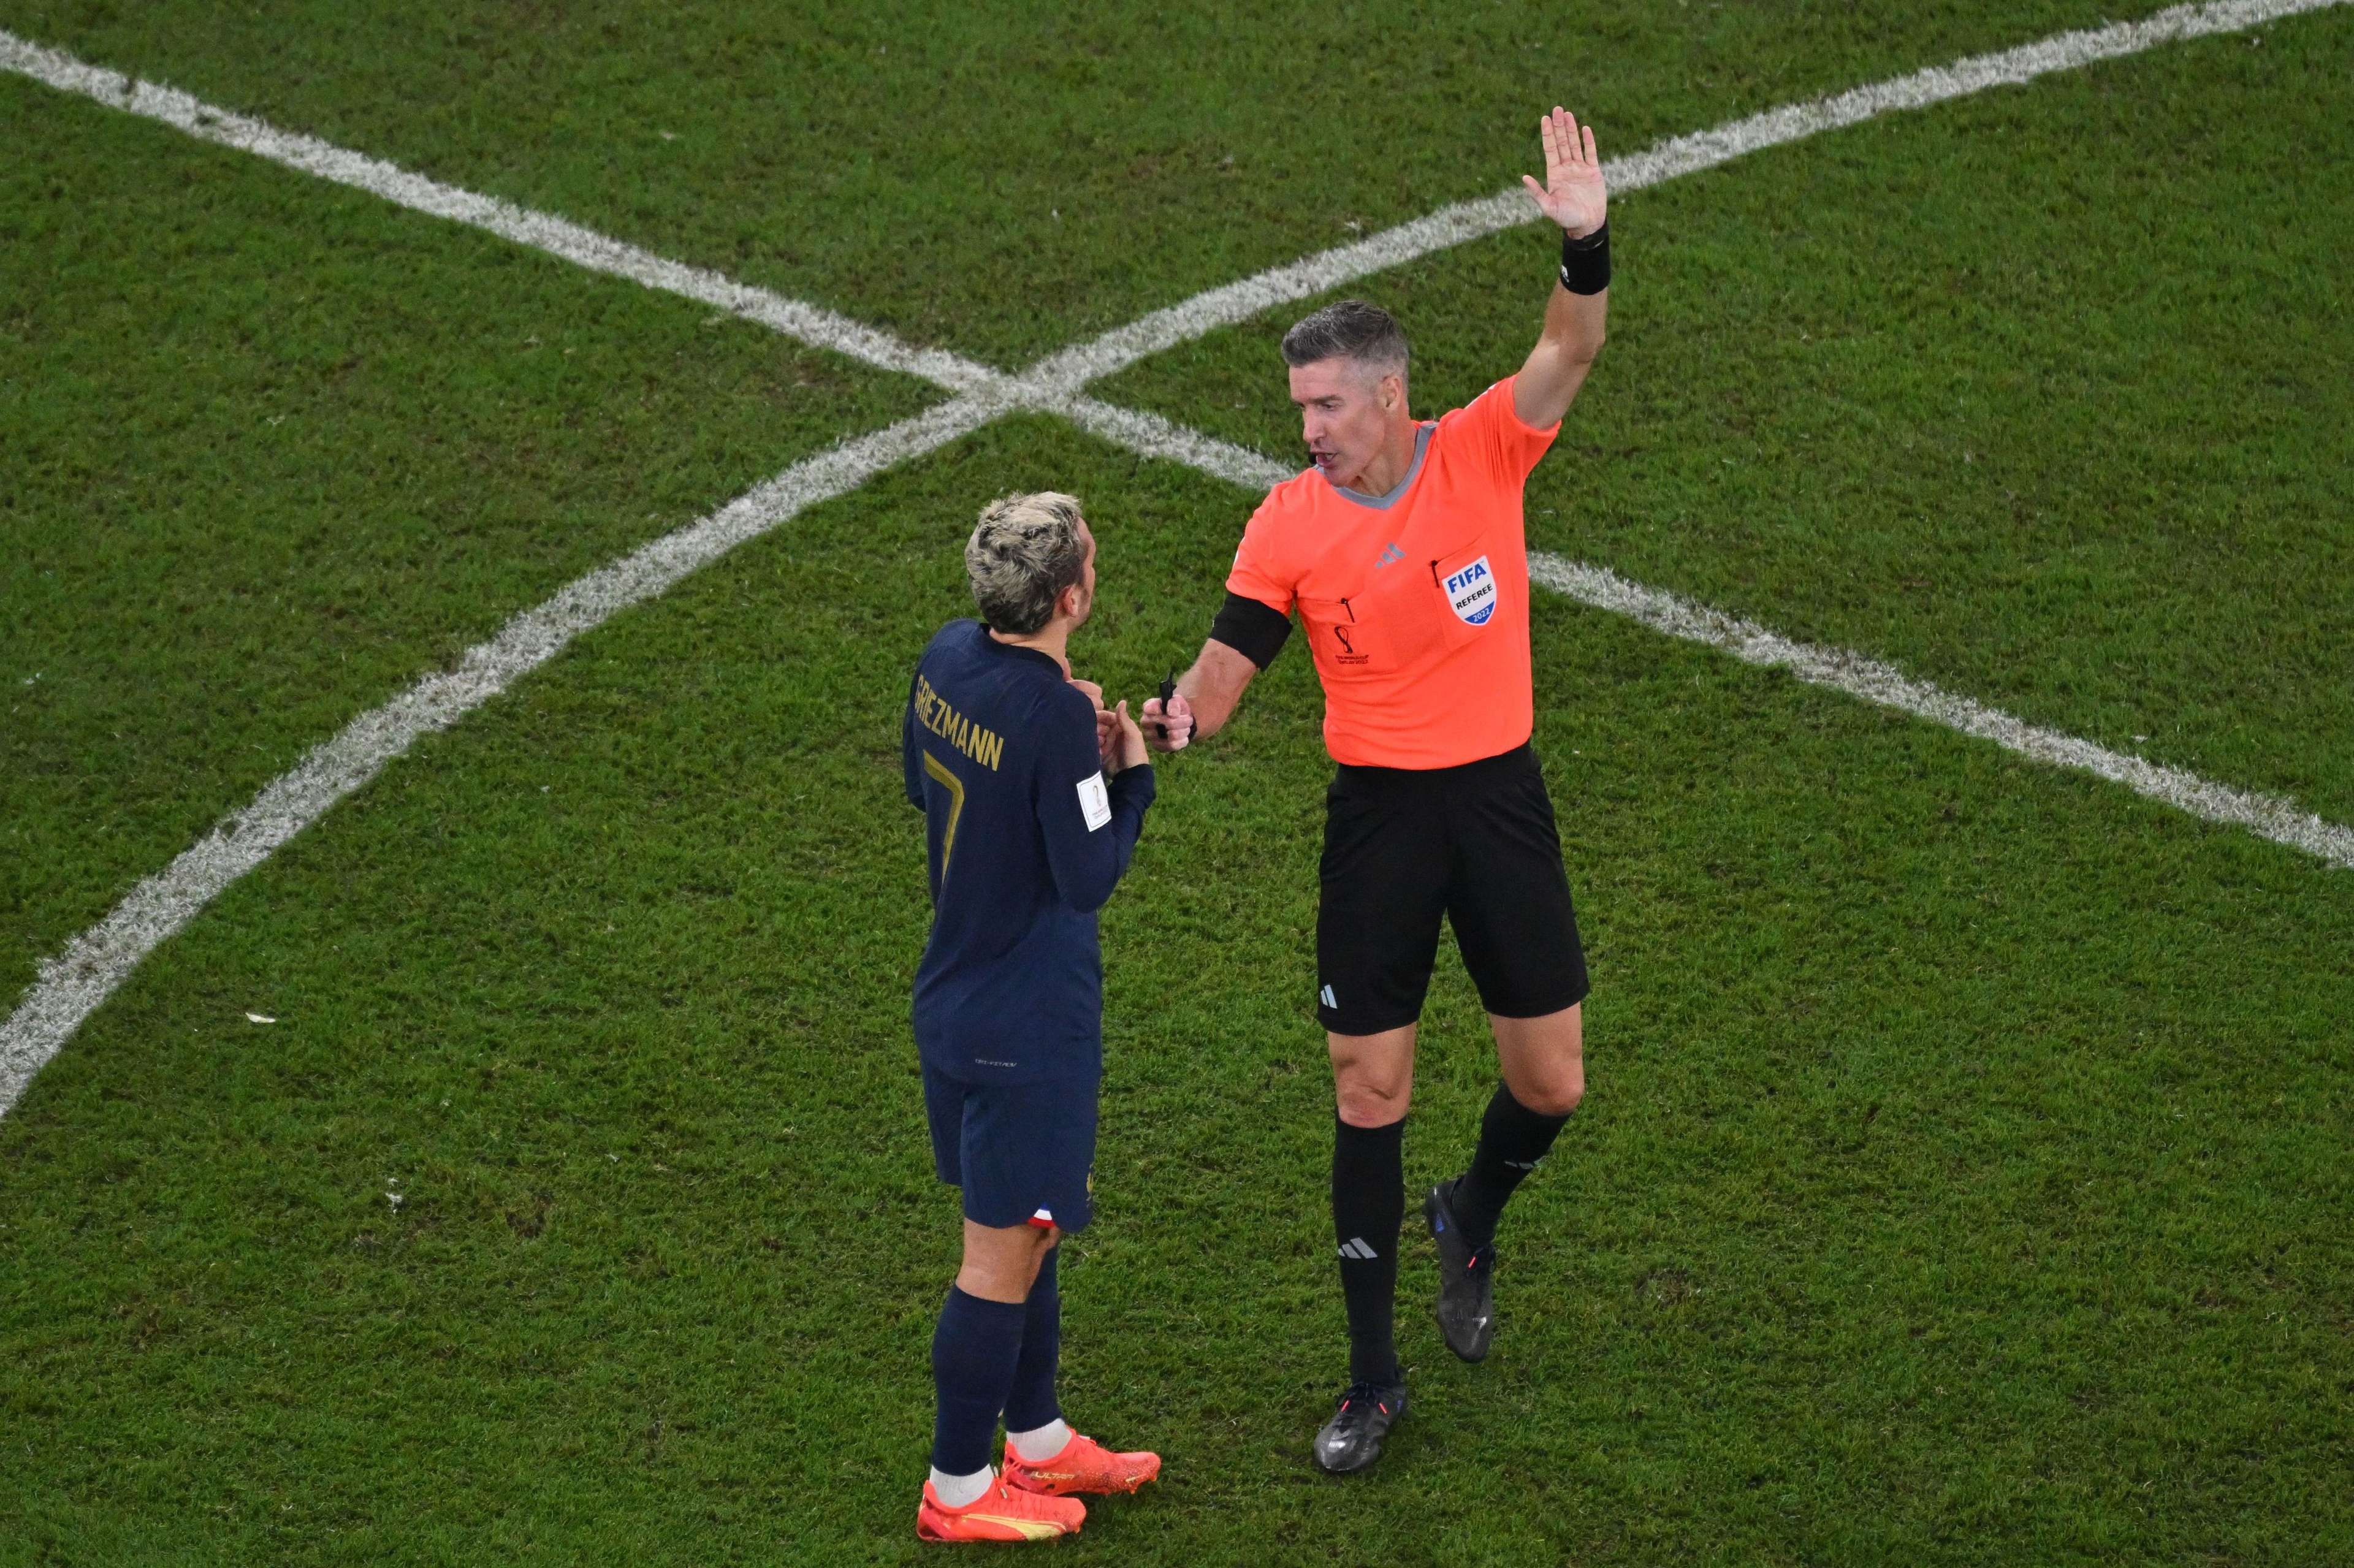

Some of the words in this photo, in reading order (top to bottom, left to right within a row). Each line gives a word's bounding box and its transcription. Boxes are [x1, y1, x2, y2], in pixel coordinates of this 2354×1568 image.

[1447, 563, 1487, 594] FIFA
[1456, 584, 1493, 610] REFEREE
[1472, 608, 1490, 622] 2022
[915, 674, 1004, 772] GRIEZMANN
[923, 749, 965, 885] 7
